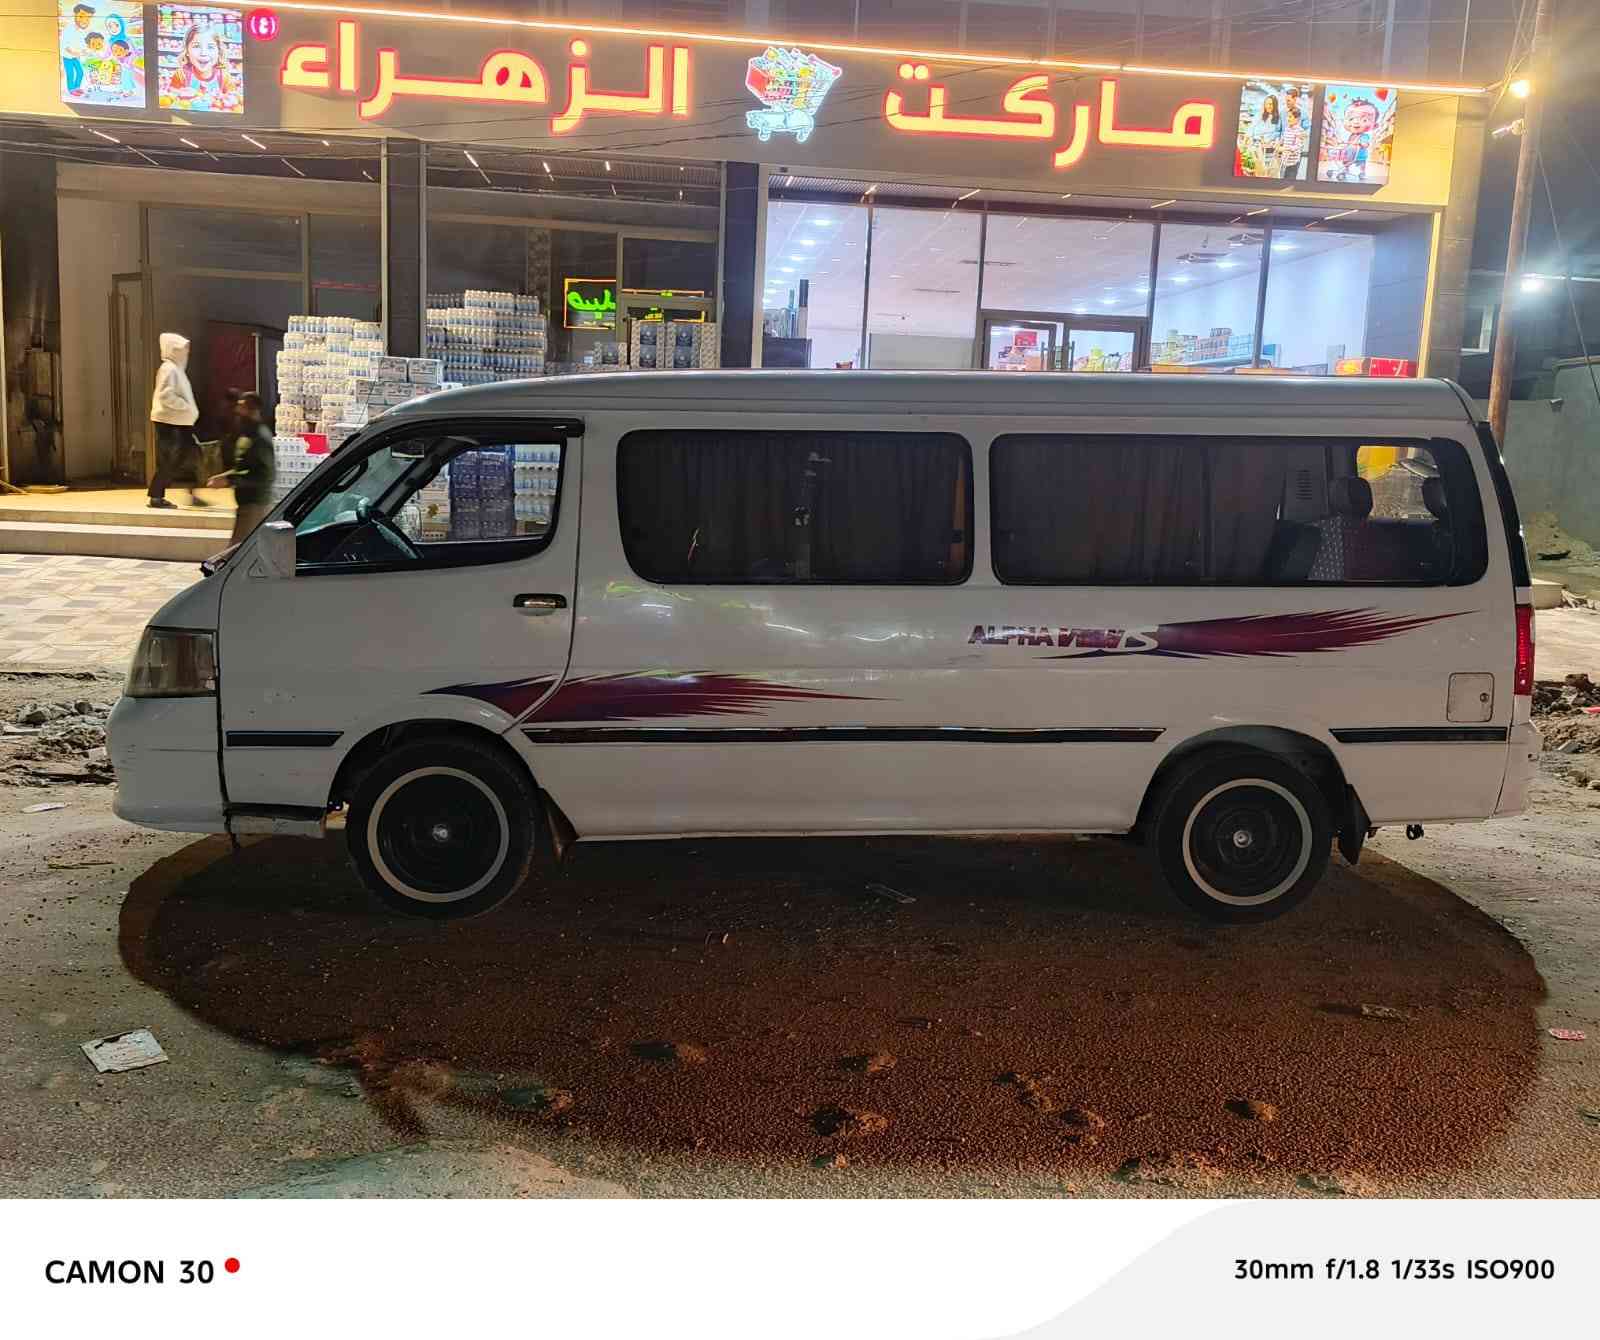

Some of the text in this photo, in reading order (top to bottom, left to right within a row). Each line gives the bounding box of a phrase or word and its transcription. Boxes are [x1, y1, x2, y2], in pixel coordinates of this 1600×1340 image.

[280, 20, 1216, 169] ماركت الزهراء
[968, 625, 1055, 647] ALPHA
